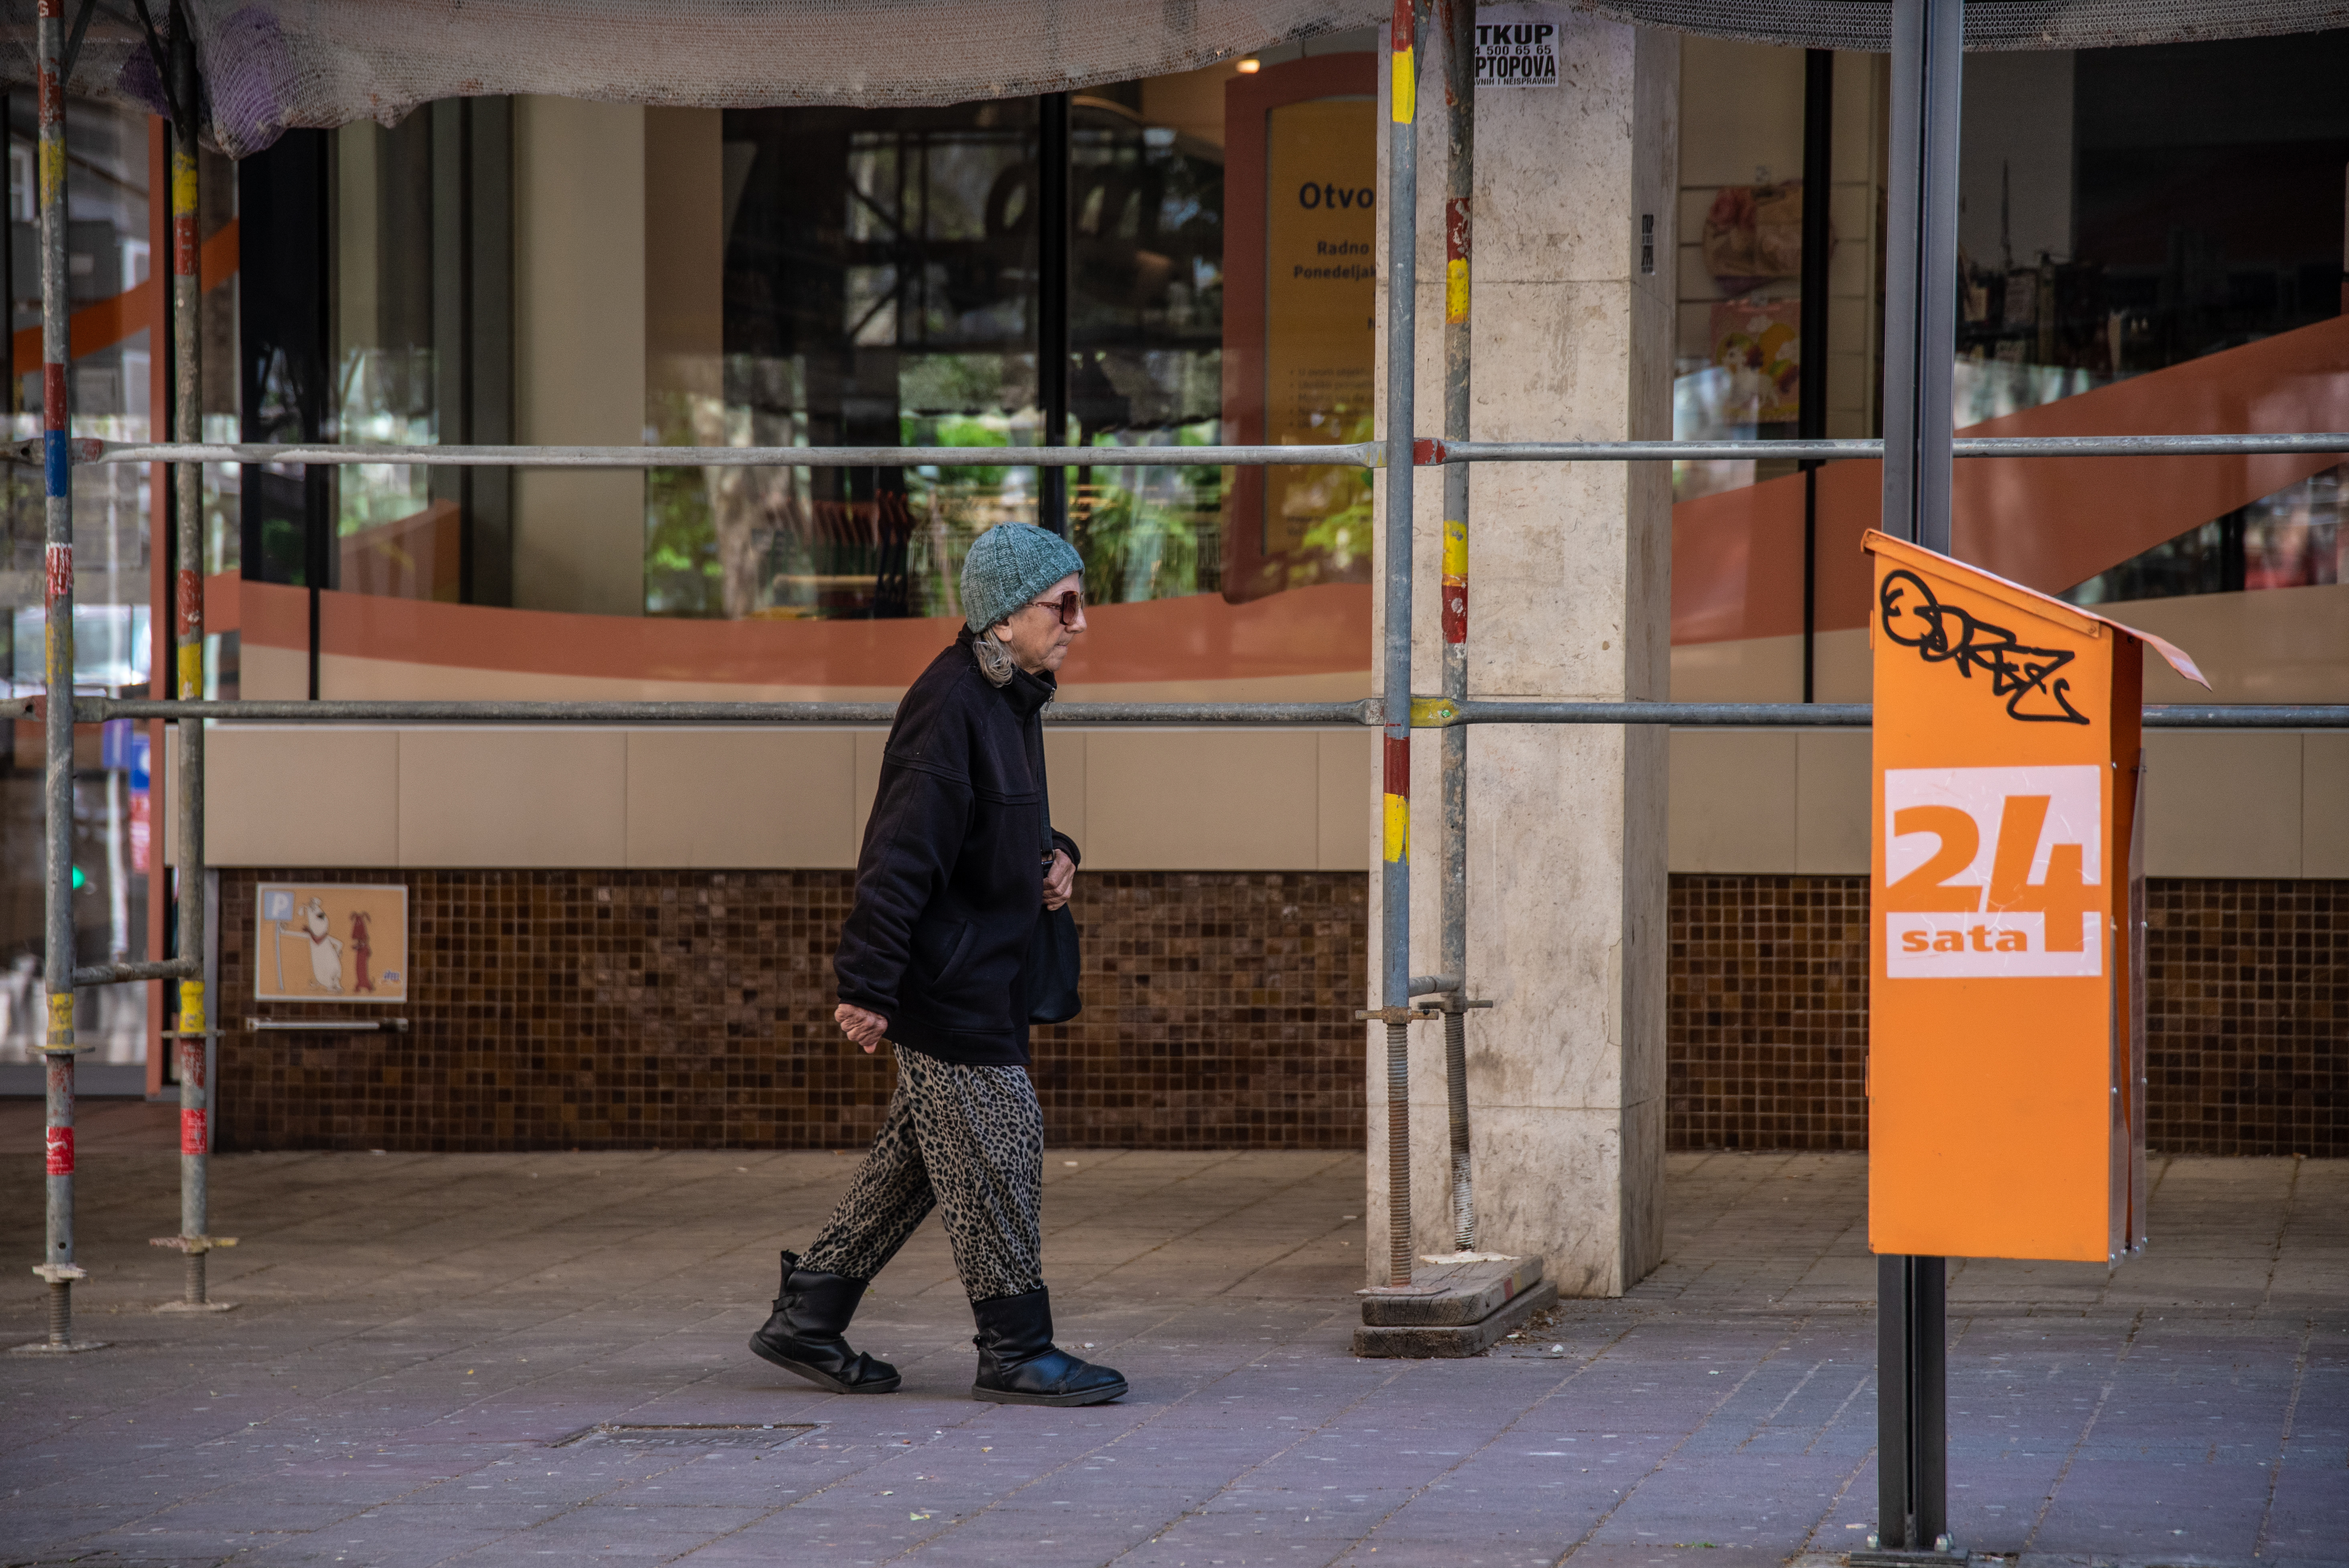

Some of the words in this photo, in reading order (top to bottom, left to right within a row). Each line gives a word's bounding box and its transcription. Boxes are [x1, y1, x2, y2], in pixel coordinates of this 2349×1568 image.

[1476, 24, 1554, 45] TKUP
[1487, 45, 1509, 55] 500
[1515, 45, 1530, 55] 65
[1536, 45, 1551, 55] 65
[1475, 55, 1556, 77] PTOPOVA
[1503, 77, 1555, 85] NEISPRAVNIH
[1299, 182, 1374, 210] Otvo
[1317, 241, 1369, 255] Radno
[1886, 795, 2101, 952] 24
[272, 893, 287, 917] P
[1902, 925, 2027, 952] sata
